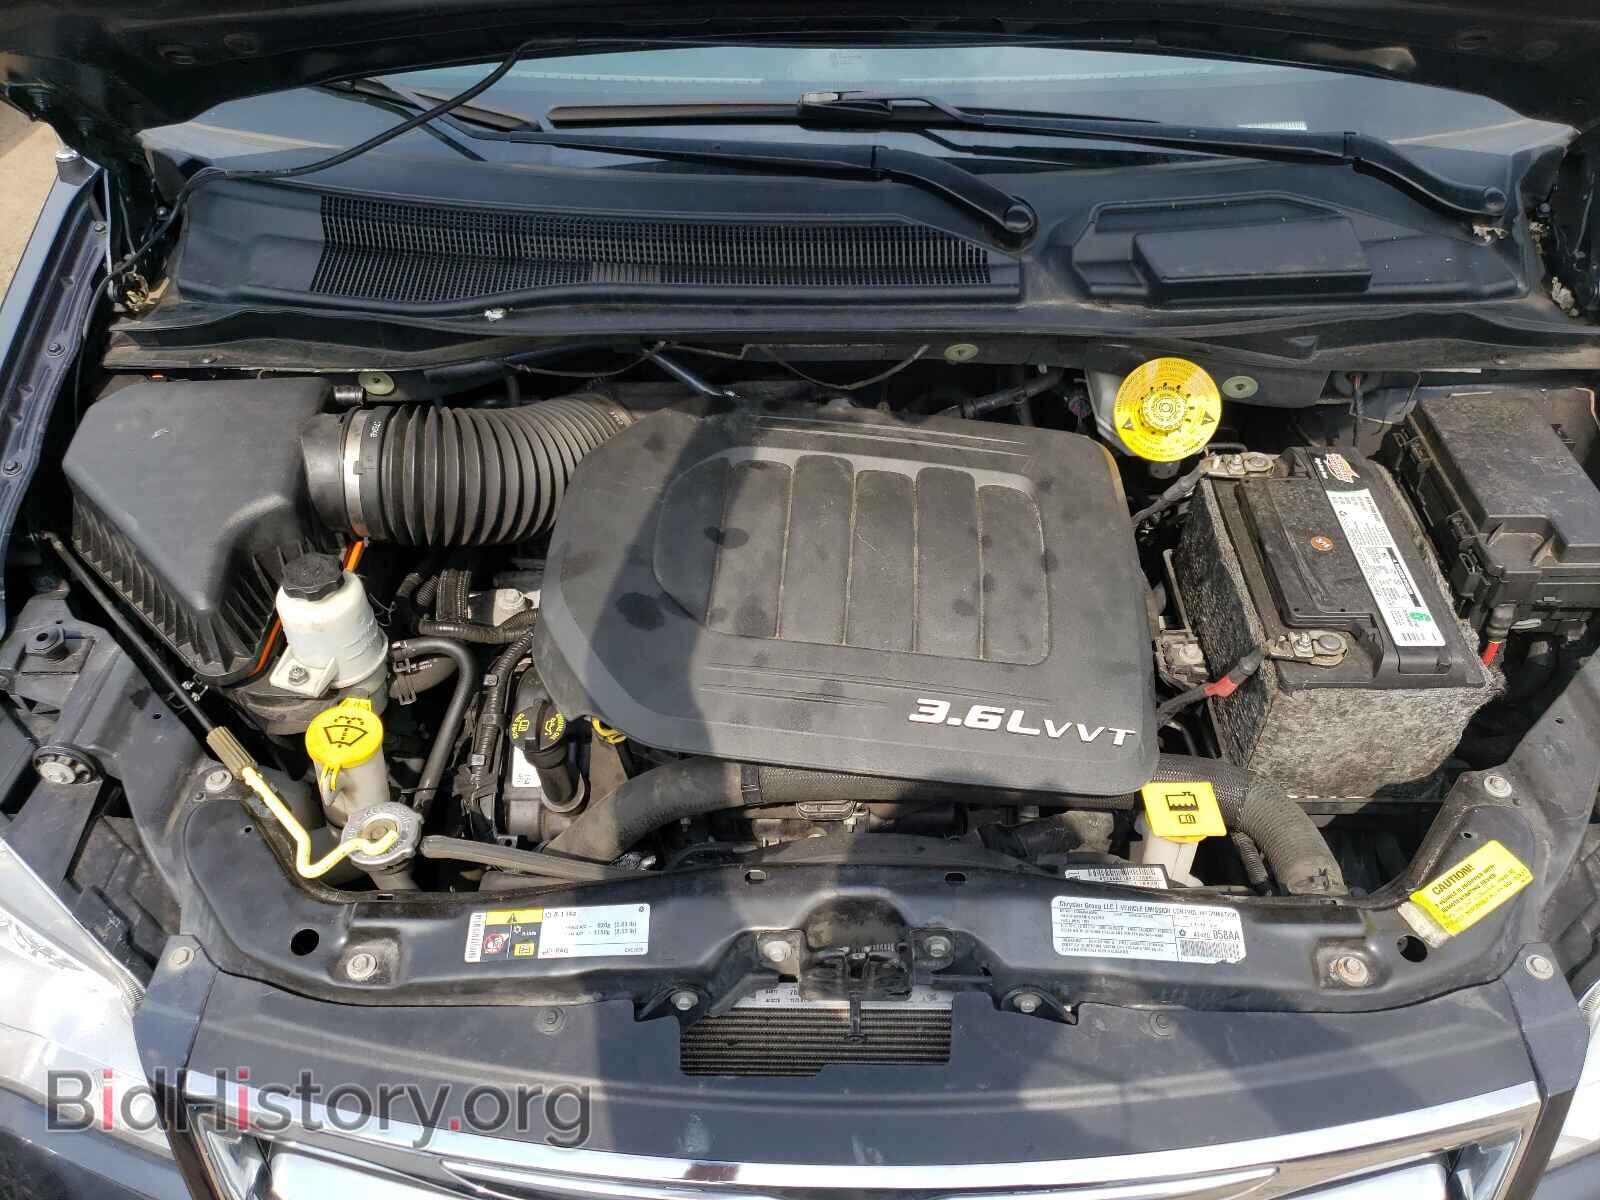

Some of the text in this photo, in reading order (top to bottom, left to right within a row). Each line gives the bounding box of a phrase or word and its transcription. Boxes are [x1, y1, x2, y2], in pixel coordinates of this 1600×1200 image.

[908, 697, 1137, 747] 3.6L VVT
[1432, 863, 1474, 895] CAUTION!
